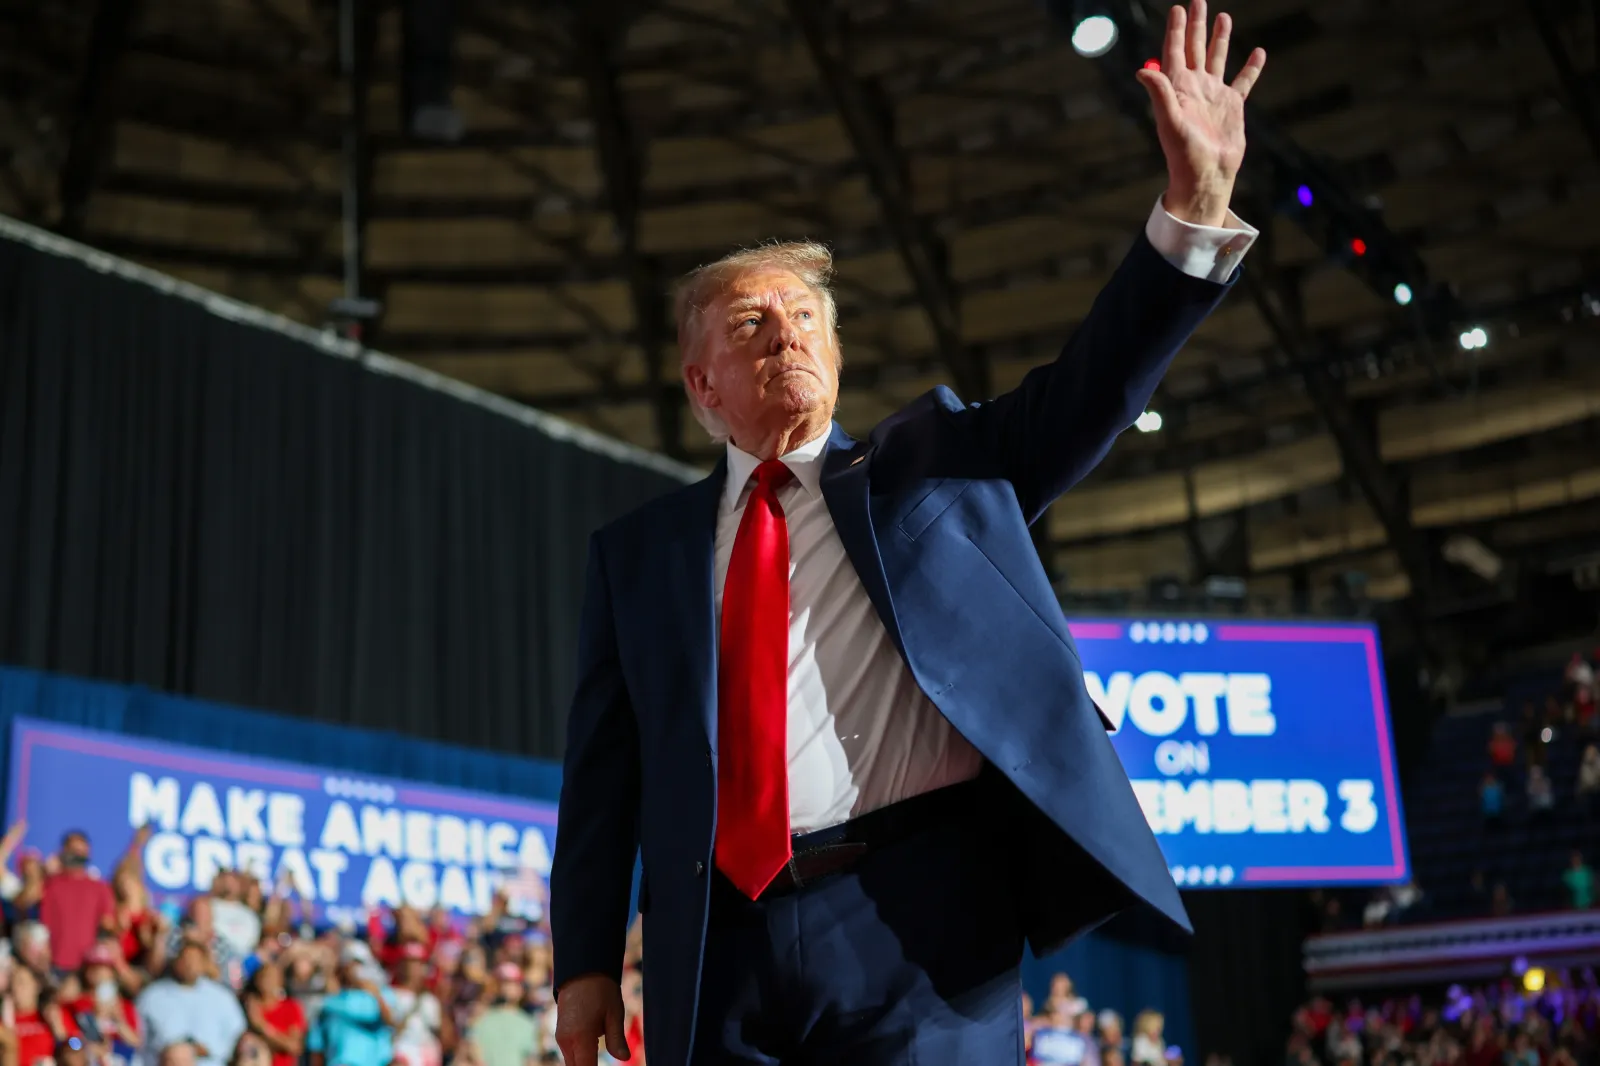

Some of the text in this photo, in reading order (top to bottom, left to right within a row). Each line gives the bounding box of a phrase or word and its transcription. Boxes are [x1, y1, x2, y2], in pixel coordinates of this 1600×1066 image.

[1083, 671, 1276, 735] VOTE
[1154, 740, 1210, 776] ON
[129, 772, 550, 874] MAKE AMERICA
[1130, 779, 1378, 834] EMBER 3
[362, 856, 543, 922] AGAI
